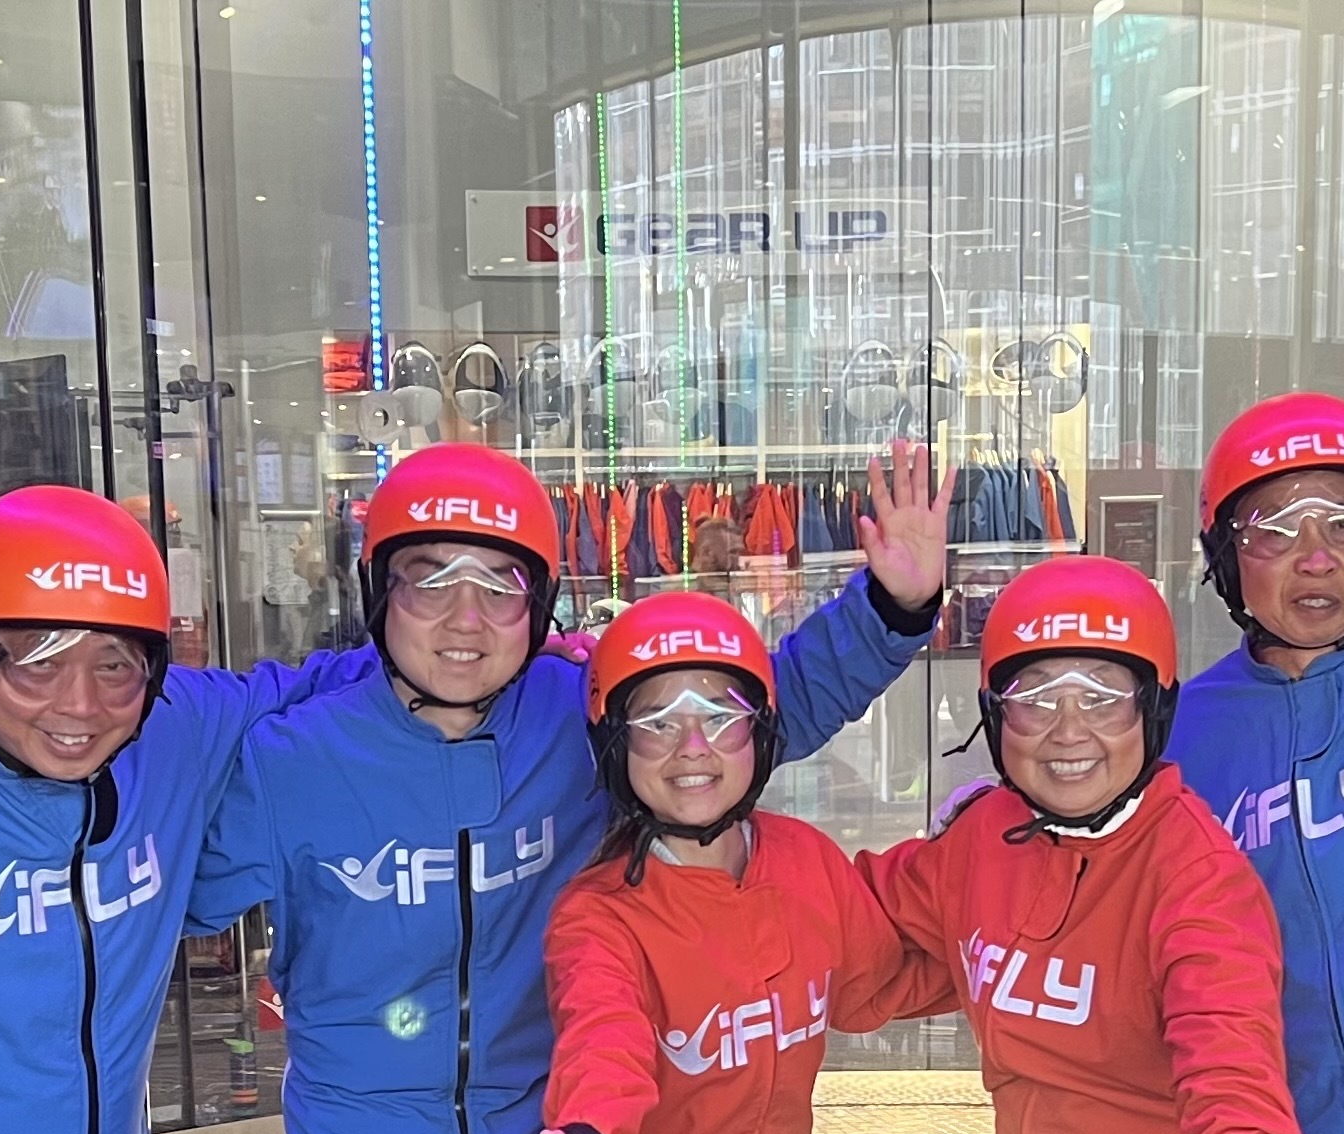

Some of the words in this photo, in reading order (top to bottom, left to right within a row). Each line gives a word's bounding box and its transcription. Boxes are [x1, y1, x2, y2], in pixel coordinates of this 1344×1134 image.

[435, 497, 517, 532] iFLY
[63, 562, 147, 599] iFLY
[659, 630, 741, 657] iFLY
[1042, 612, 1129, 642] iFLY
[394, 816, 554, 905] iFLY
[14, 833, 162, 935] iFLY
[718, 969, 832, 1070] iFLY
